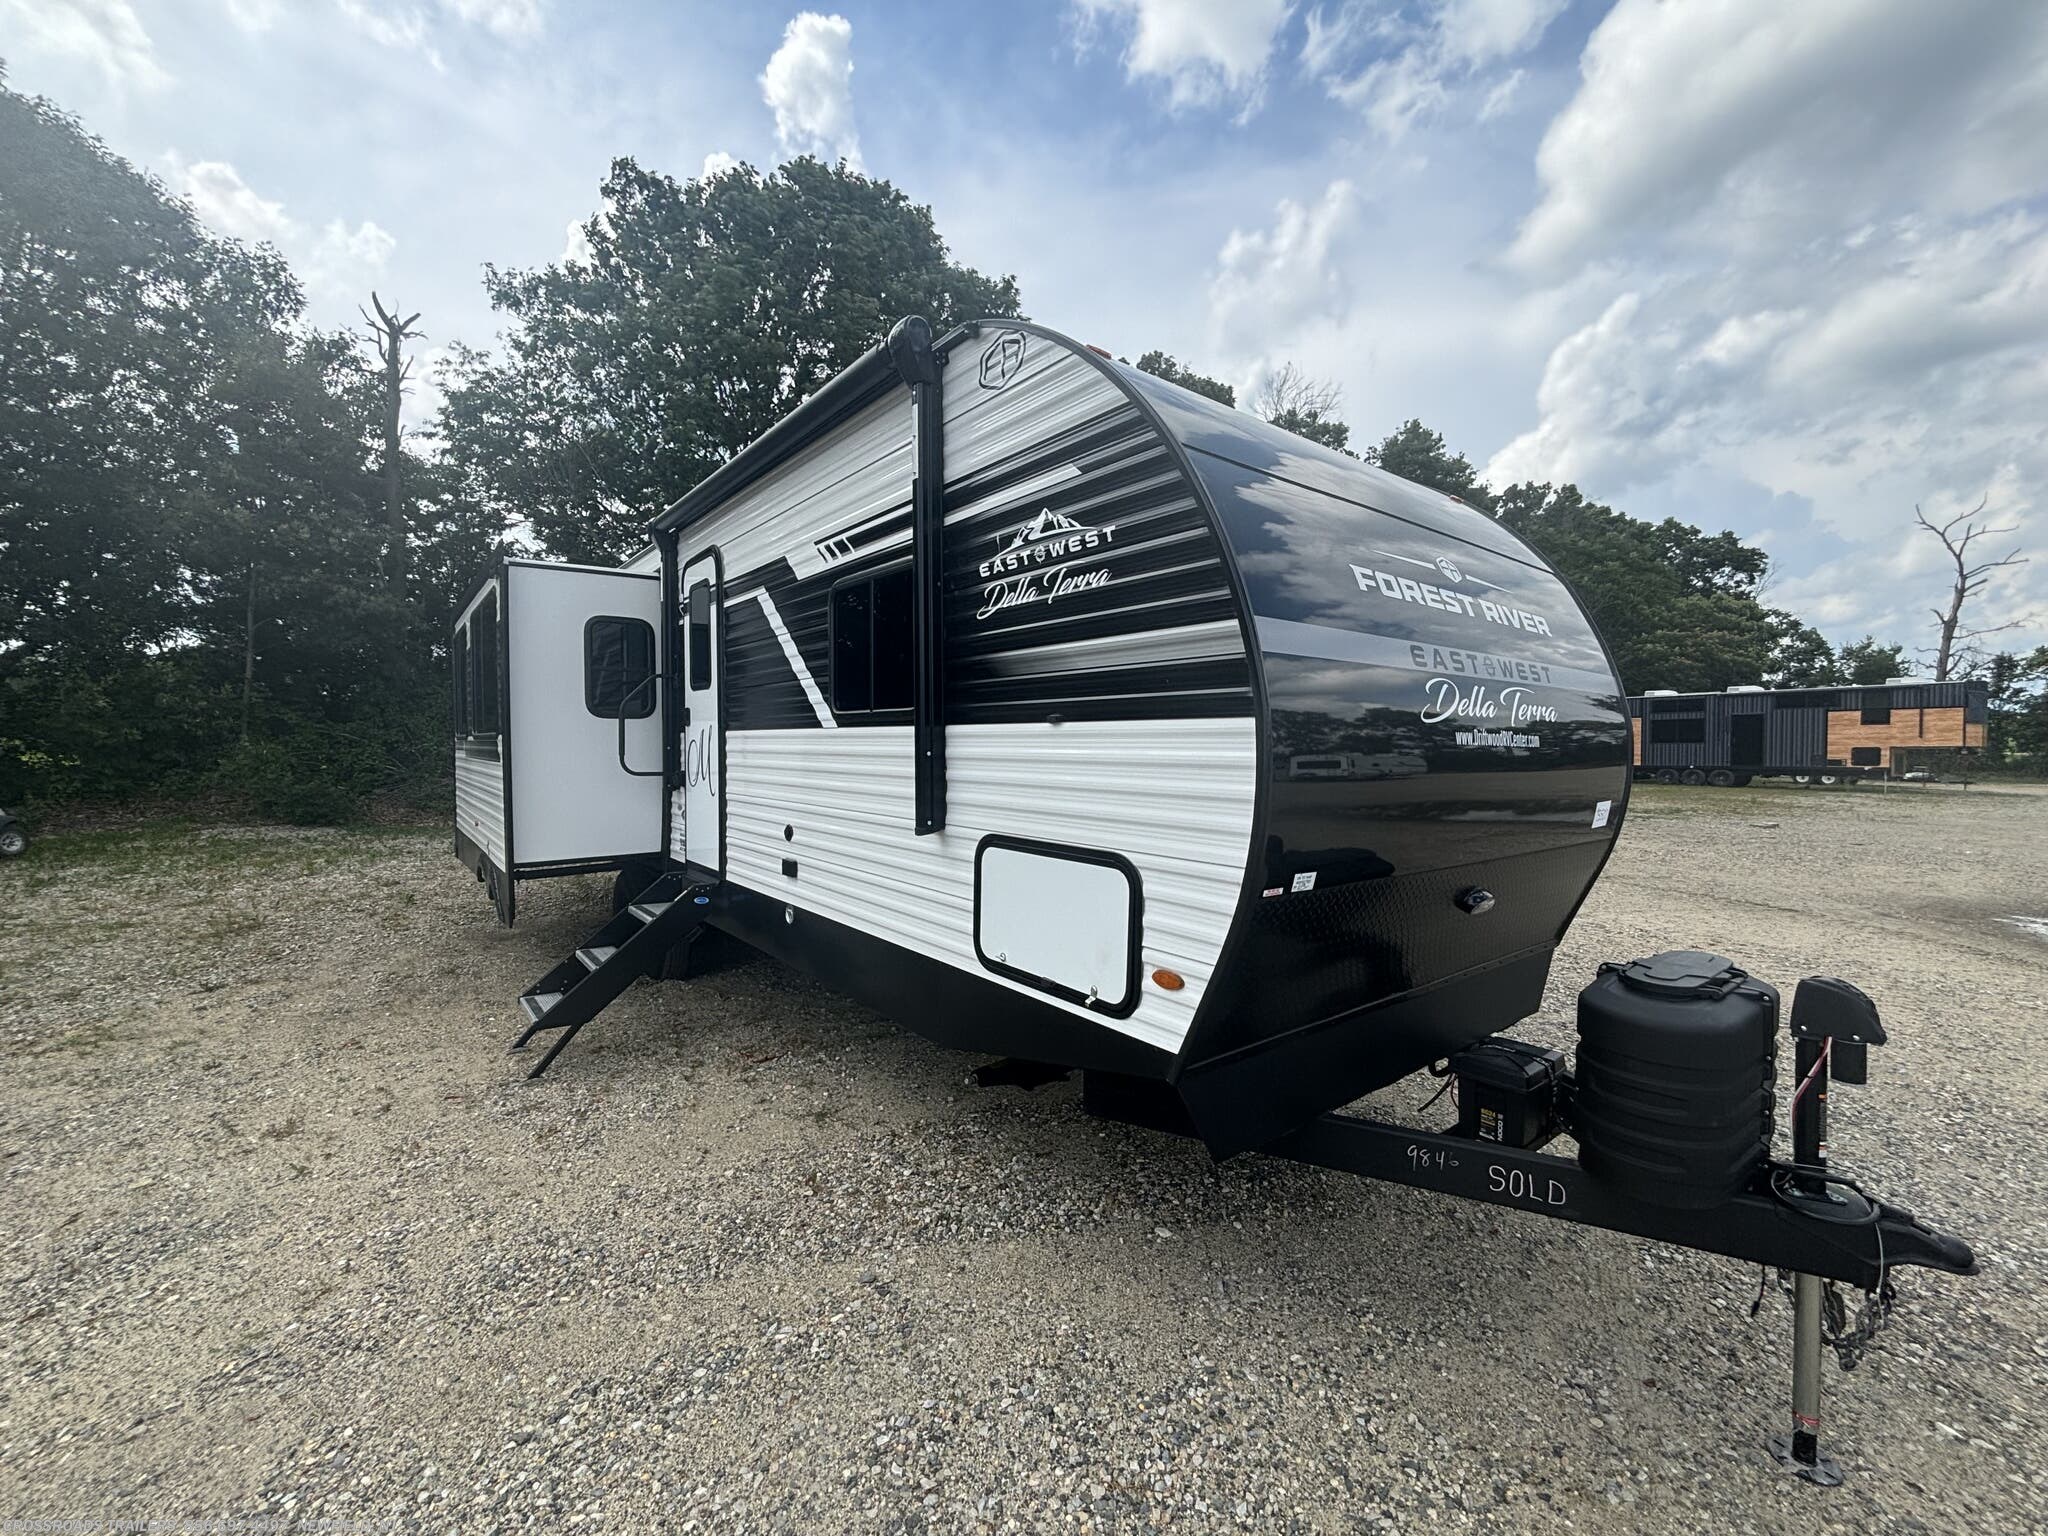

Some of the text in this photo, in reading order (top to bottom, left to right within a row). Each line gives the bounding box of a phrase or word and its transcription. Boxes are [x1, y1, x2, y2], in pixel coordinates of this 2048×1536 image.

[979, 525, 1116, 577] EAST WEST
[976, 560, 1113, 620] Della Terra
[1349, 564, 1553, 637] FOREST RIVER
[1410, 645, 1551, 684] EAST WEST
[1420, 677, 1558, 727] Della Terra
[1488, 1165, 1566, 1205] SOLD
